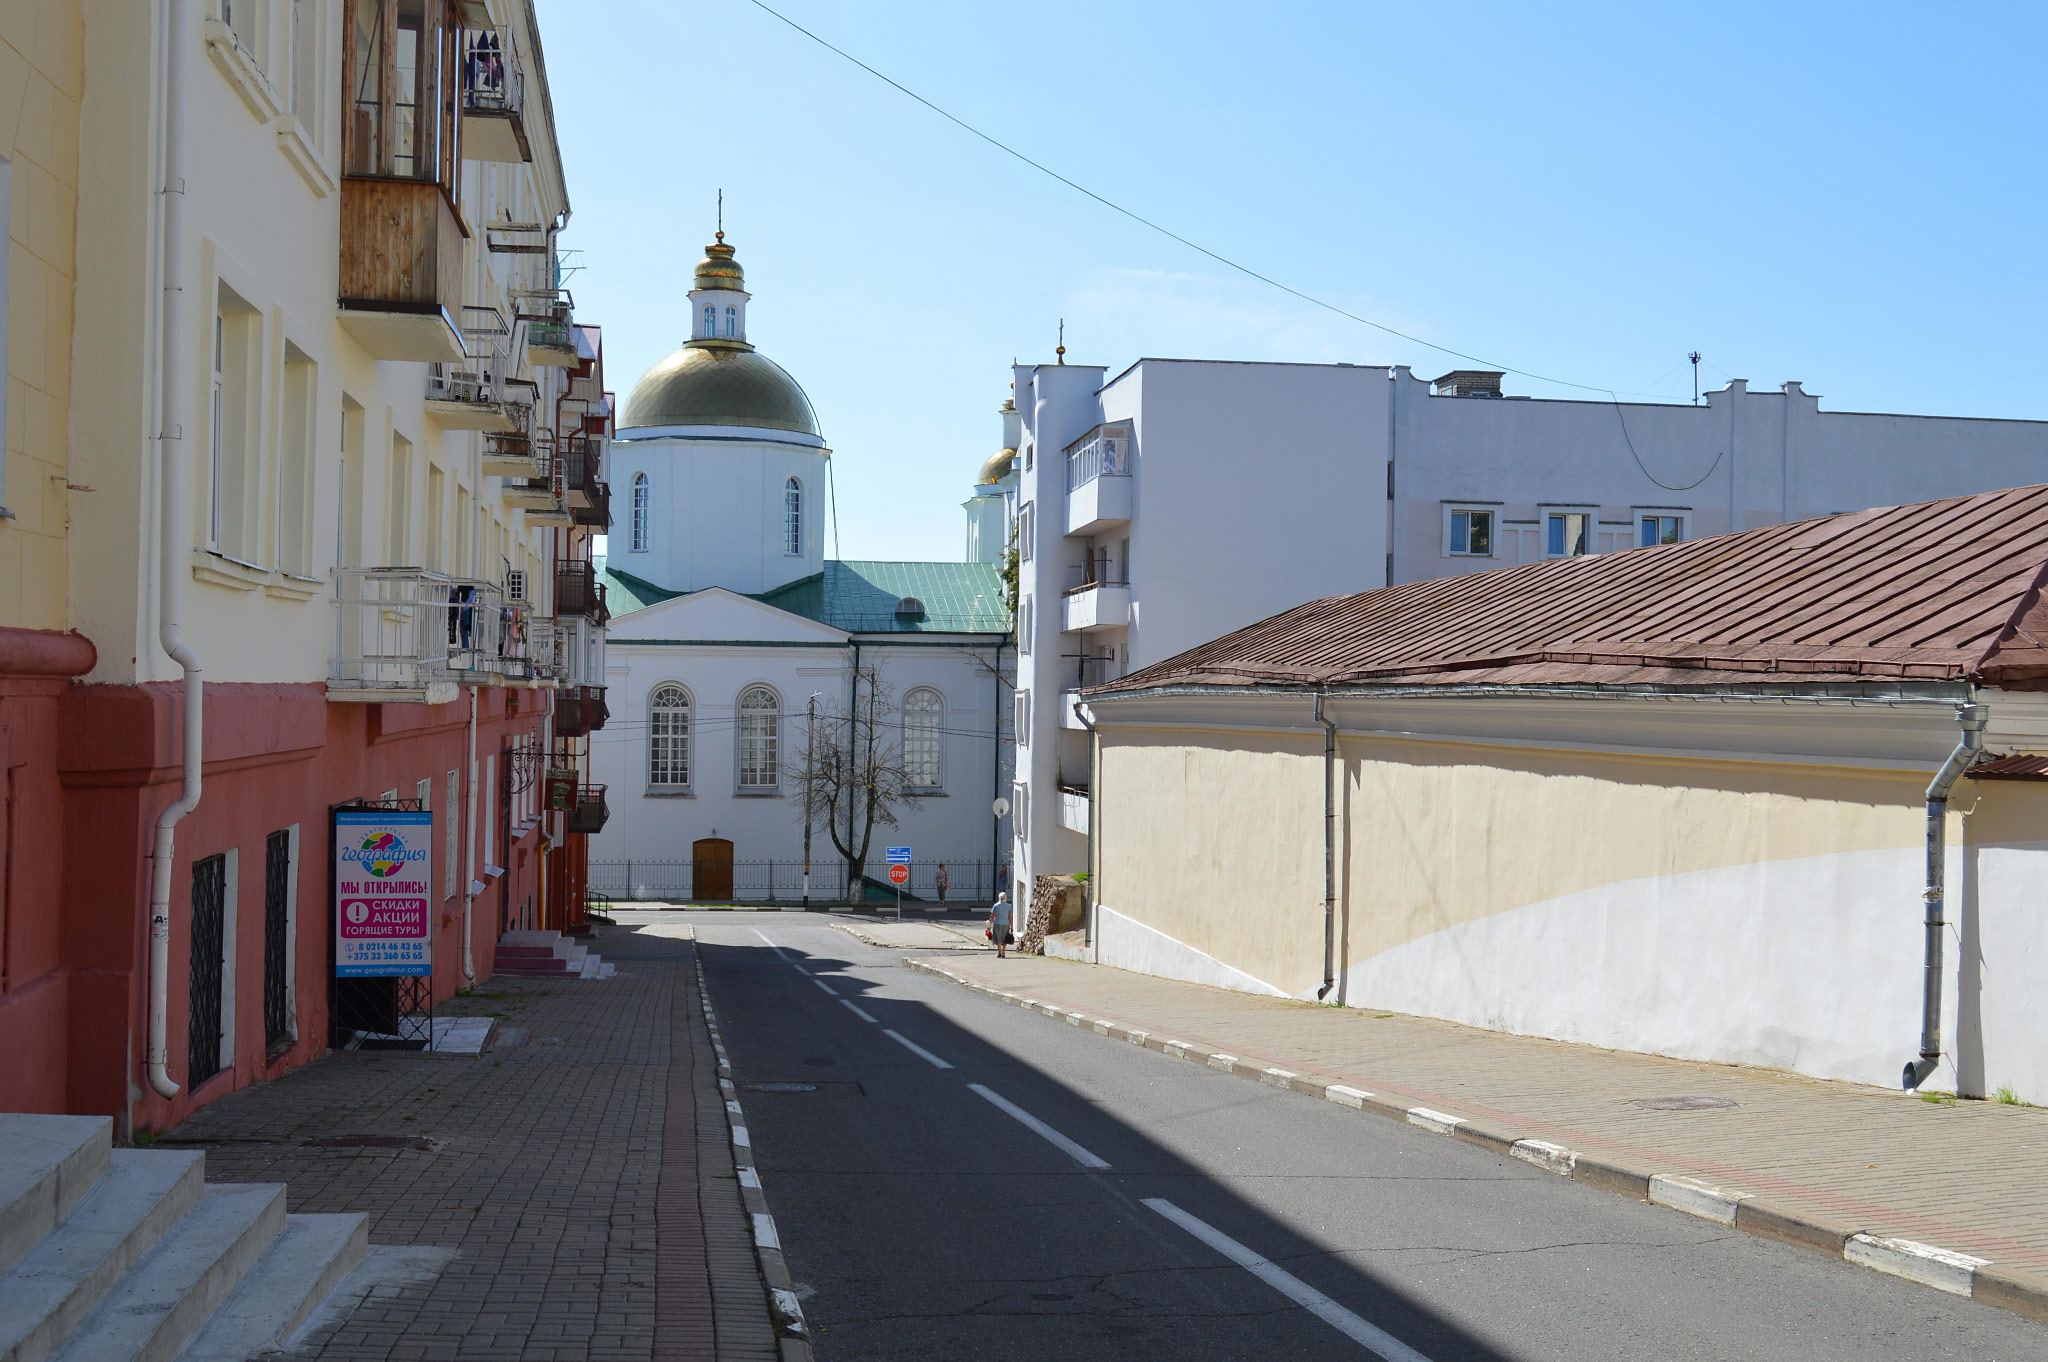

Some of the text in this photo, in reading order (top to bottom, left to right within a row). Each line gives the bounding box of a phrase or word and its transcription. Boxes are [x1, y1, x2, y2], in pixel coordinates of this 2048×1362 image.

[890, 870, 907, 878] STOP
[341, 881, 428, 894] МЫ ОТКРЫЛИСЬ!
[372, 900, 420, 911] СКИДКИ
[372, 912, 420, 925] АКЦИИ
[346, 926, 420, 936] ГОРЯЩИЕ ТУРЫ
[358, 942, 423, 951] 8 0214 46 43 65
[347, 952, 423, 961] +375 33 360 65 65
